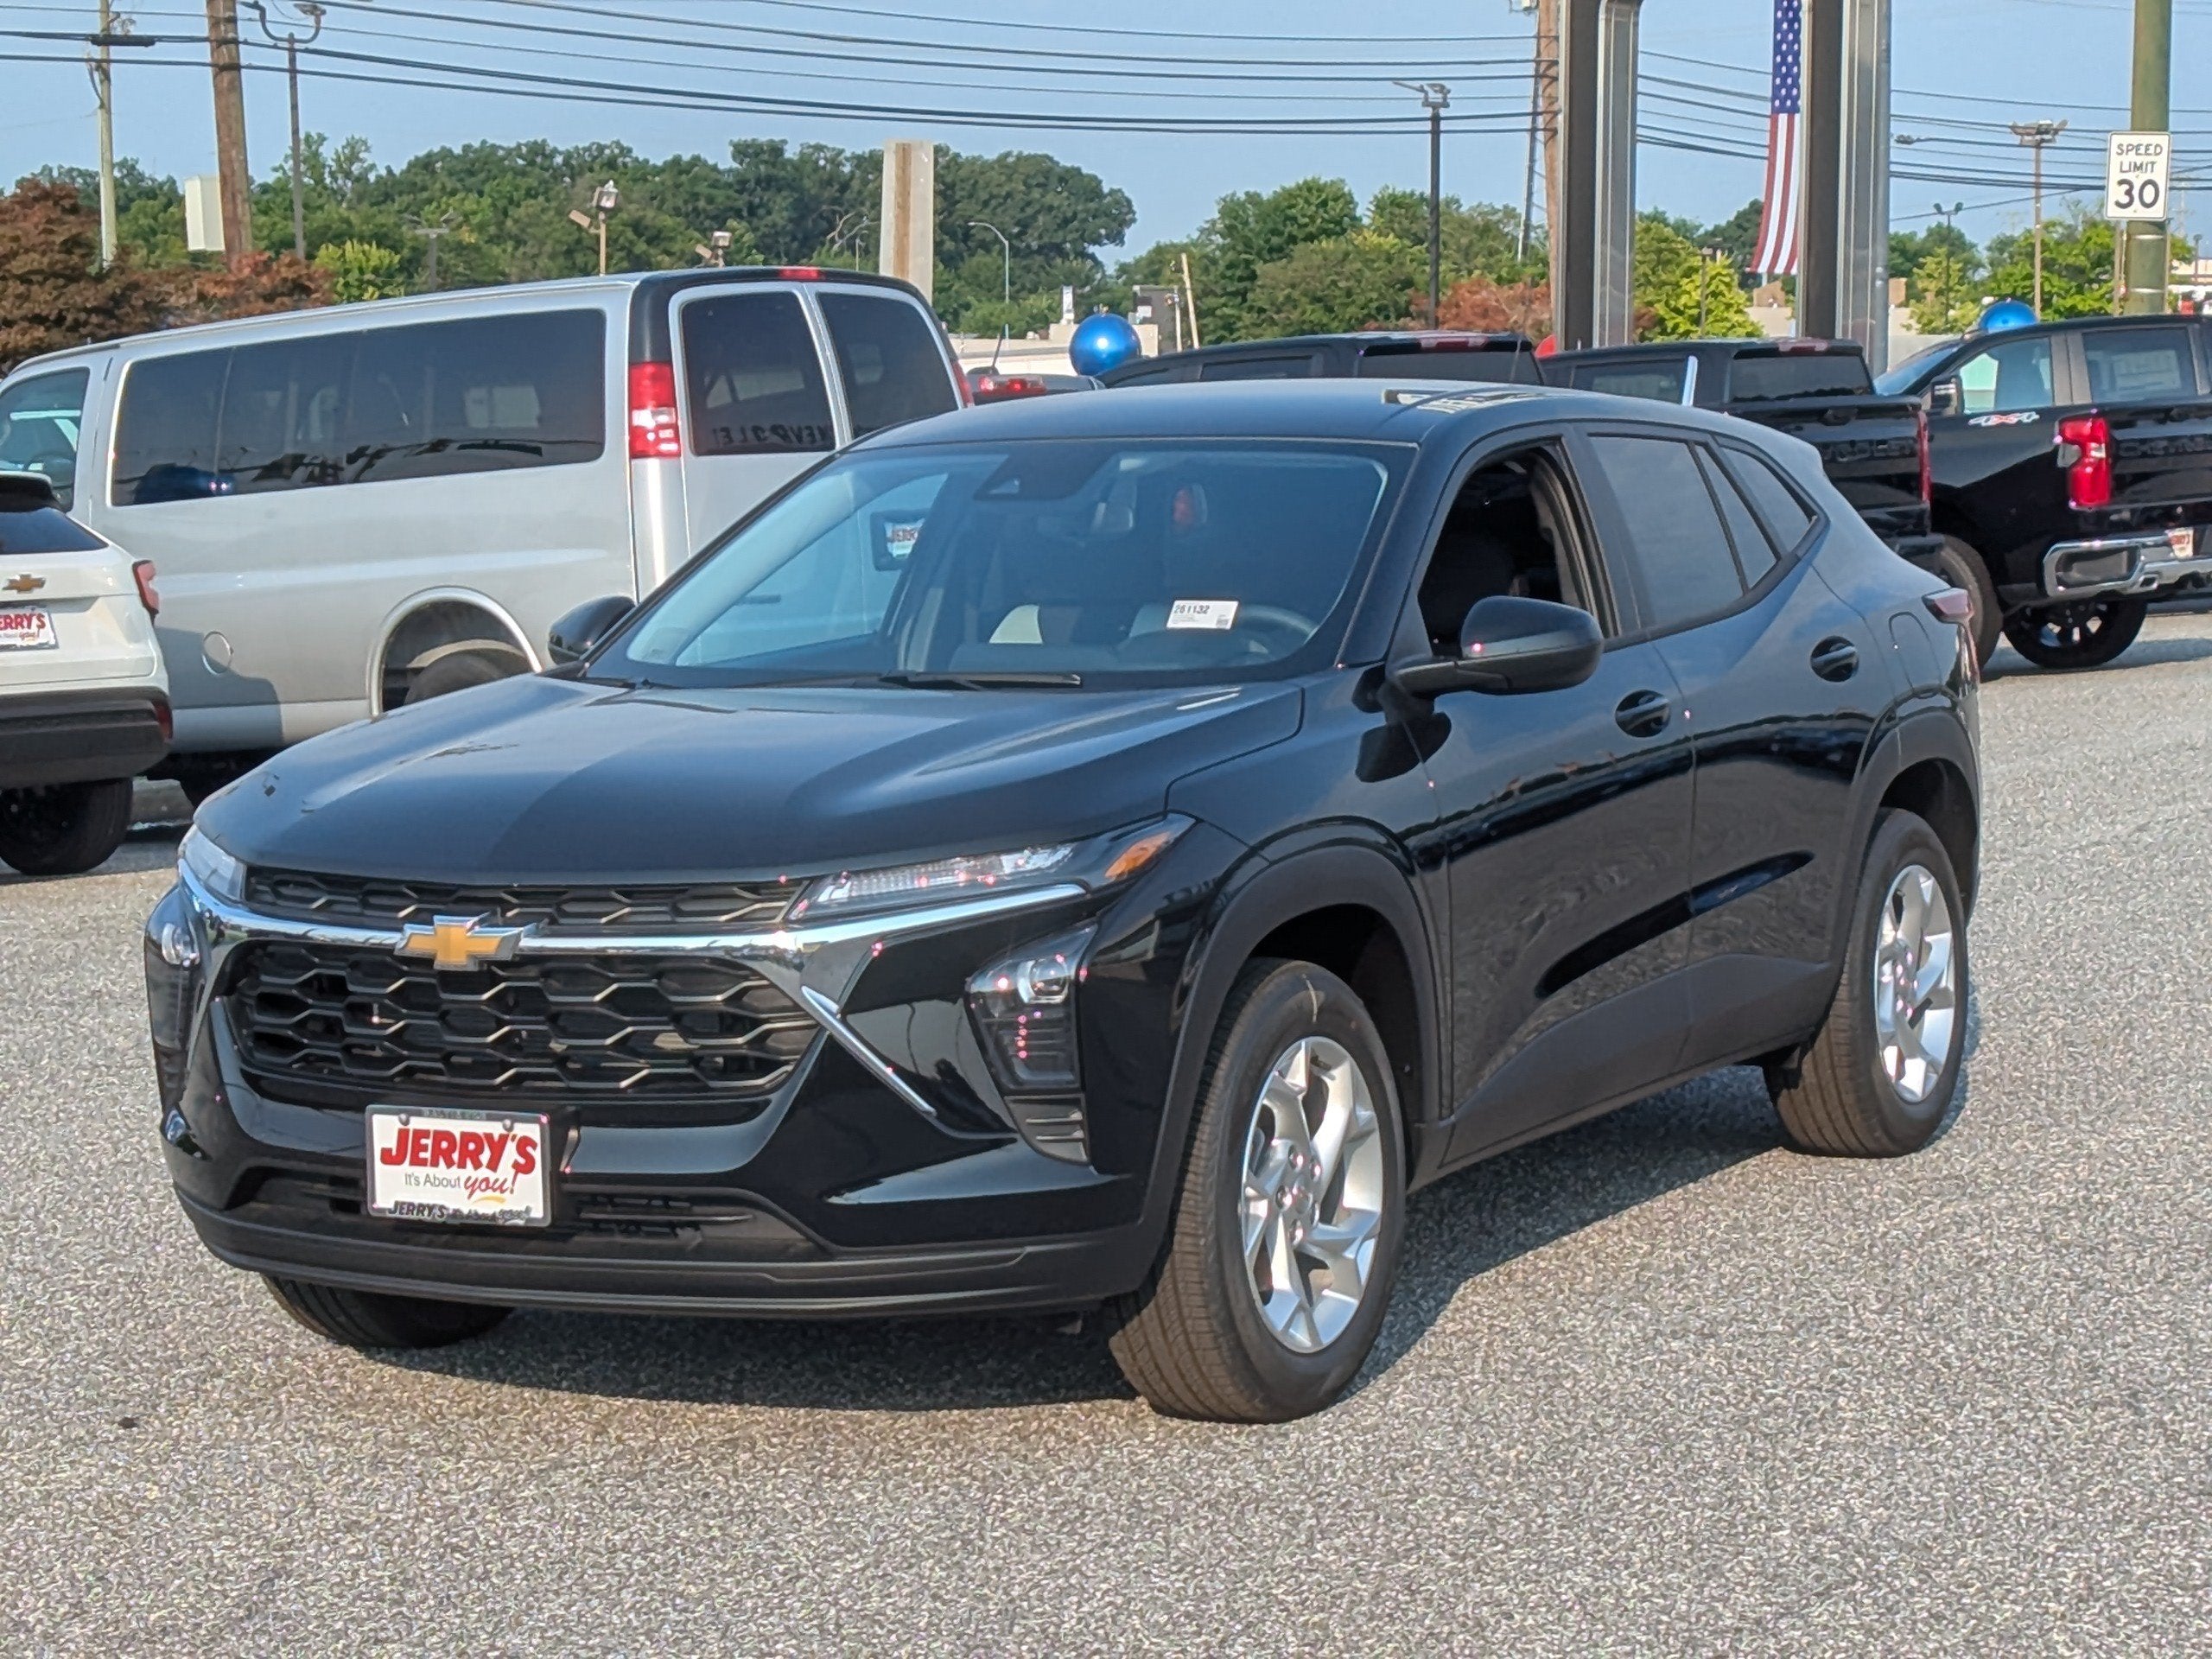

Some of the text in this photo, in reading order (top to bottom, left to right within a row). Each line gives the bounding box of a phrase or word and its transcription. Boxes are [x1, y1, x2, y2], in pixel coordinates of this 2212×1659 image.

[2115, 143, 2164, 156] SPEED
[2119, 161, 2158, 174] LIMIT
[2113, 178, 2160, 209] 30
[1173, 604, 1211, 614] 261132
[379, 1128, 538, 1175] JERRY'S
[404, 1171, 519, 1200] It's About you!
